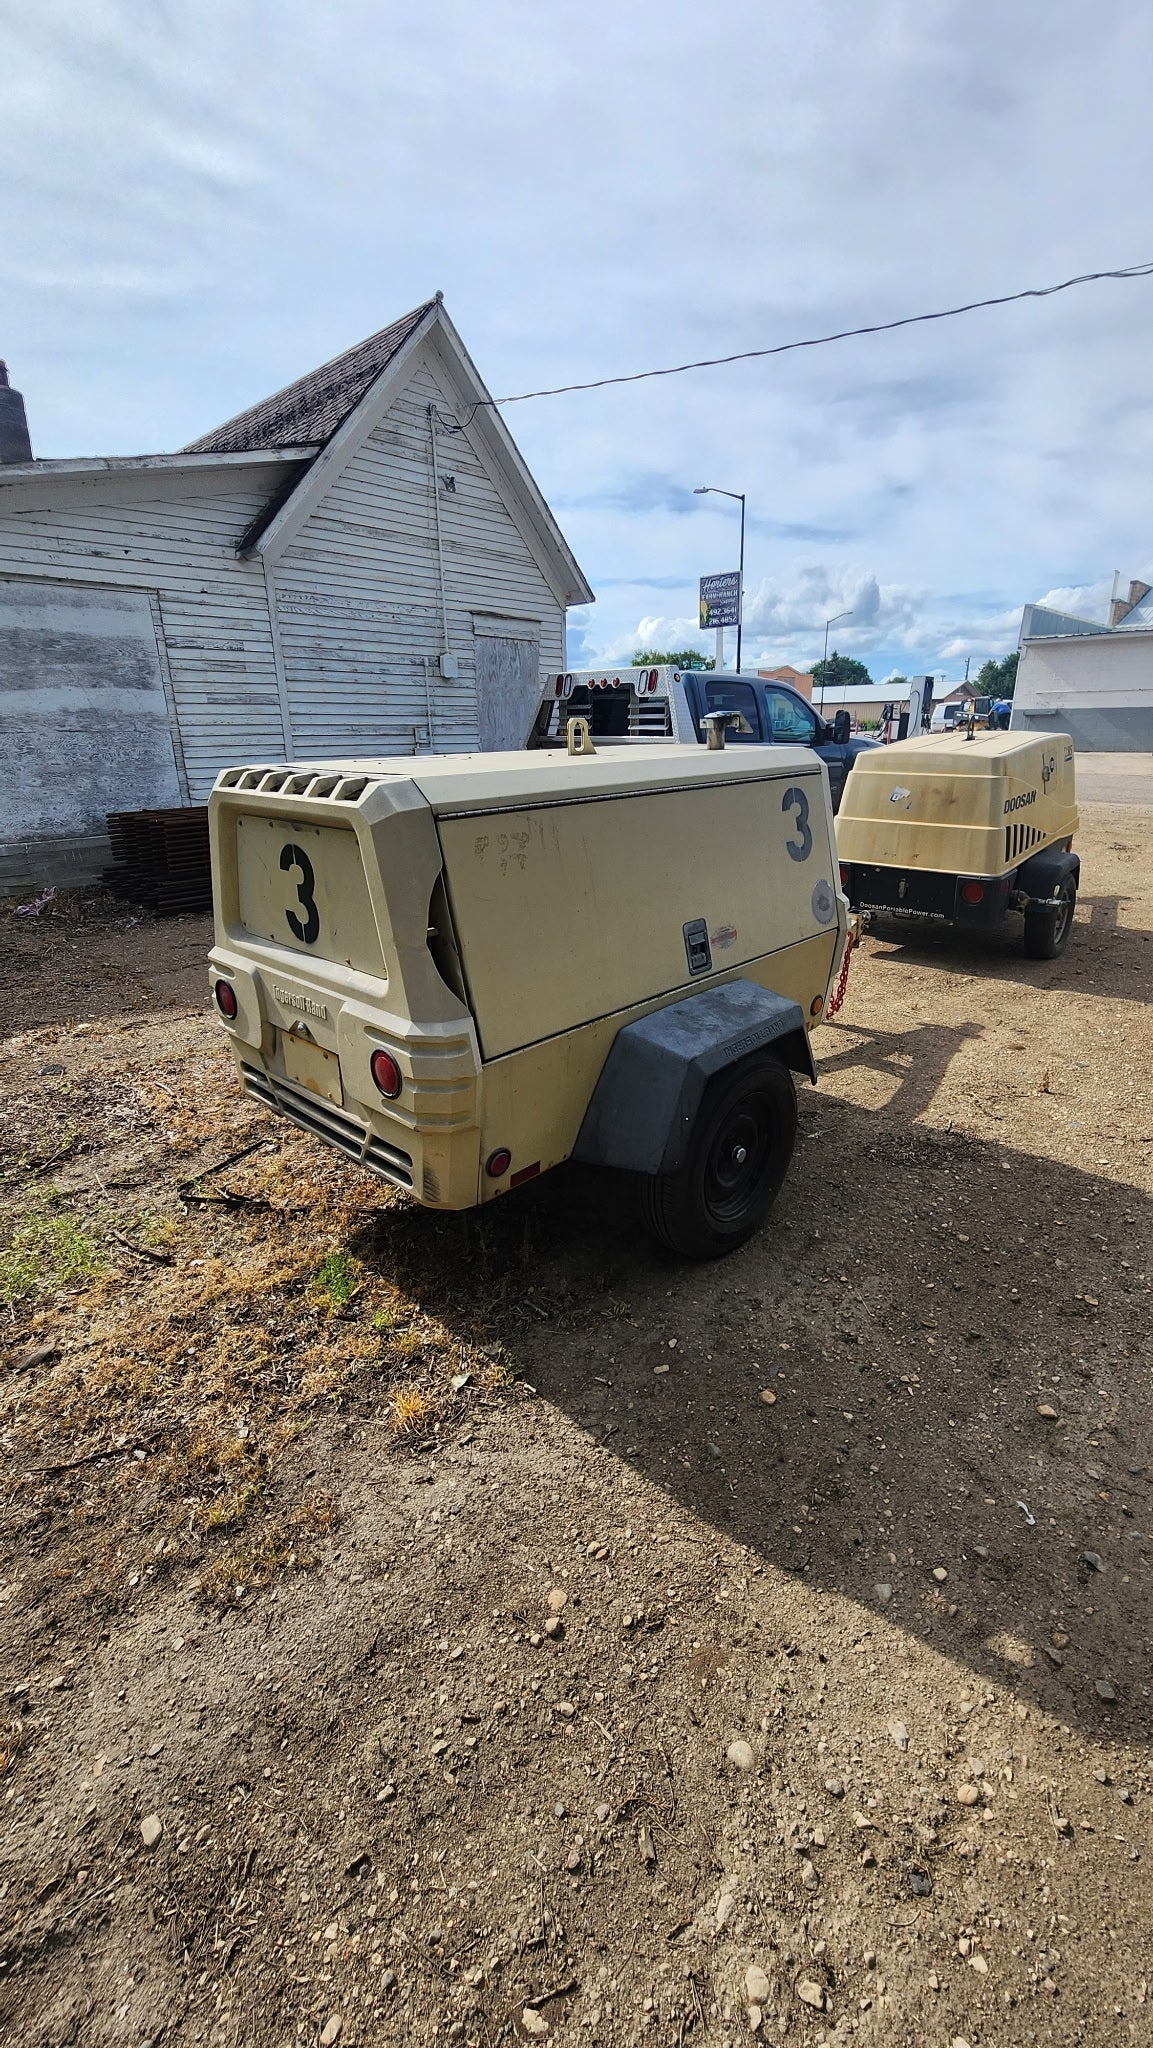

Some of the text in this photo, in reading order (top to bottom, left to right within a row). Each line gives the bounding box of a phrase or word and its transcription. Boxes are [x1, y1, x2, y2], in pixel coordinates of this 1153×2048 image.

[782, 788, 812, 862] 3
[1004, 790, 1037, 814] DOOSAN
[279, 844, 319, 944] 3
[860, 902, 945, 918] DoosanPortablePower.com
